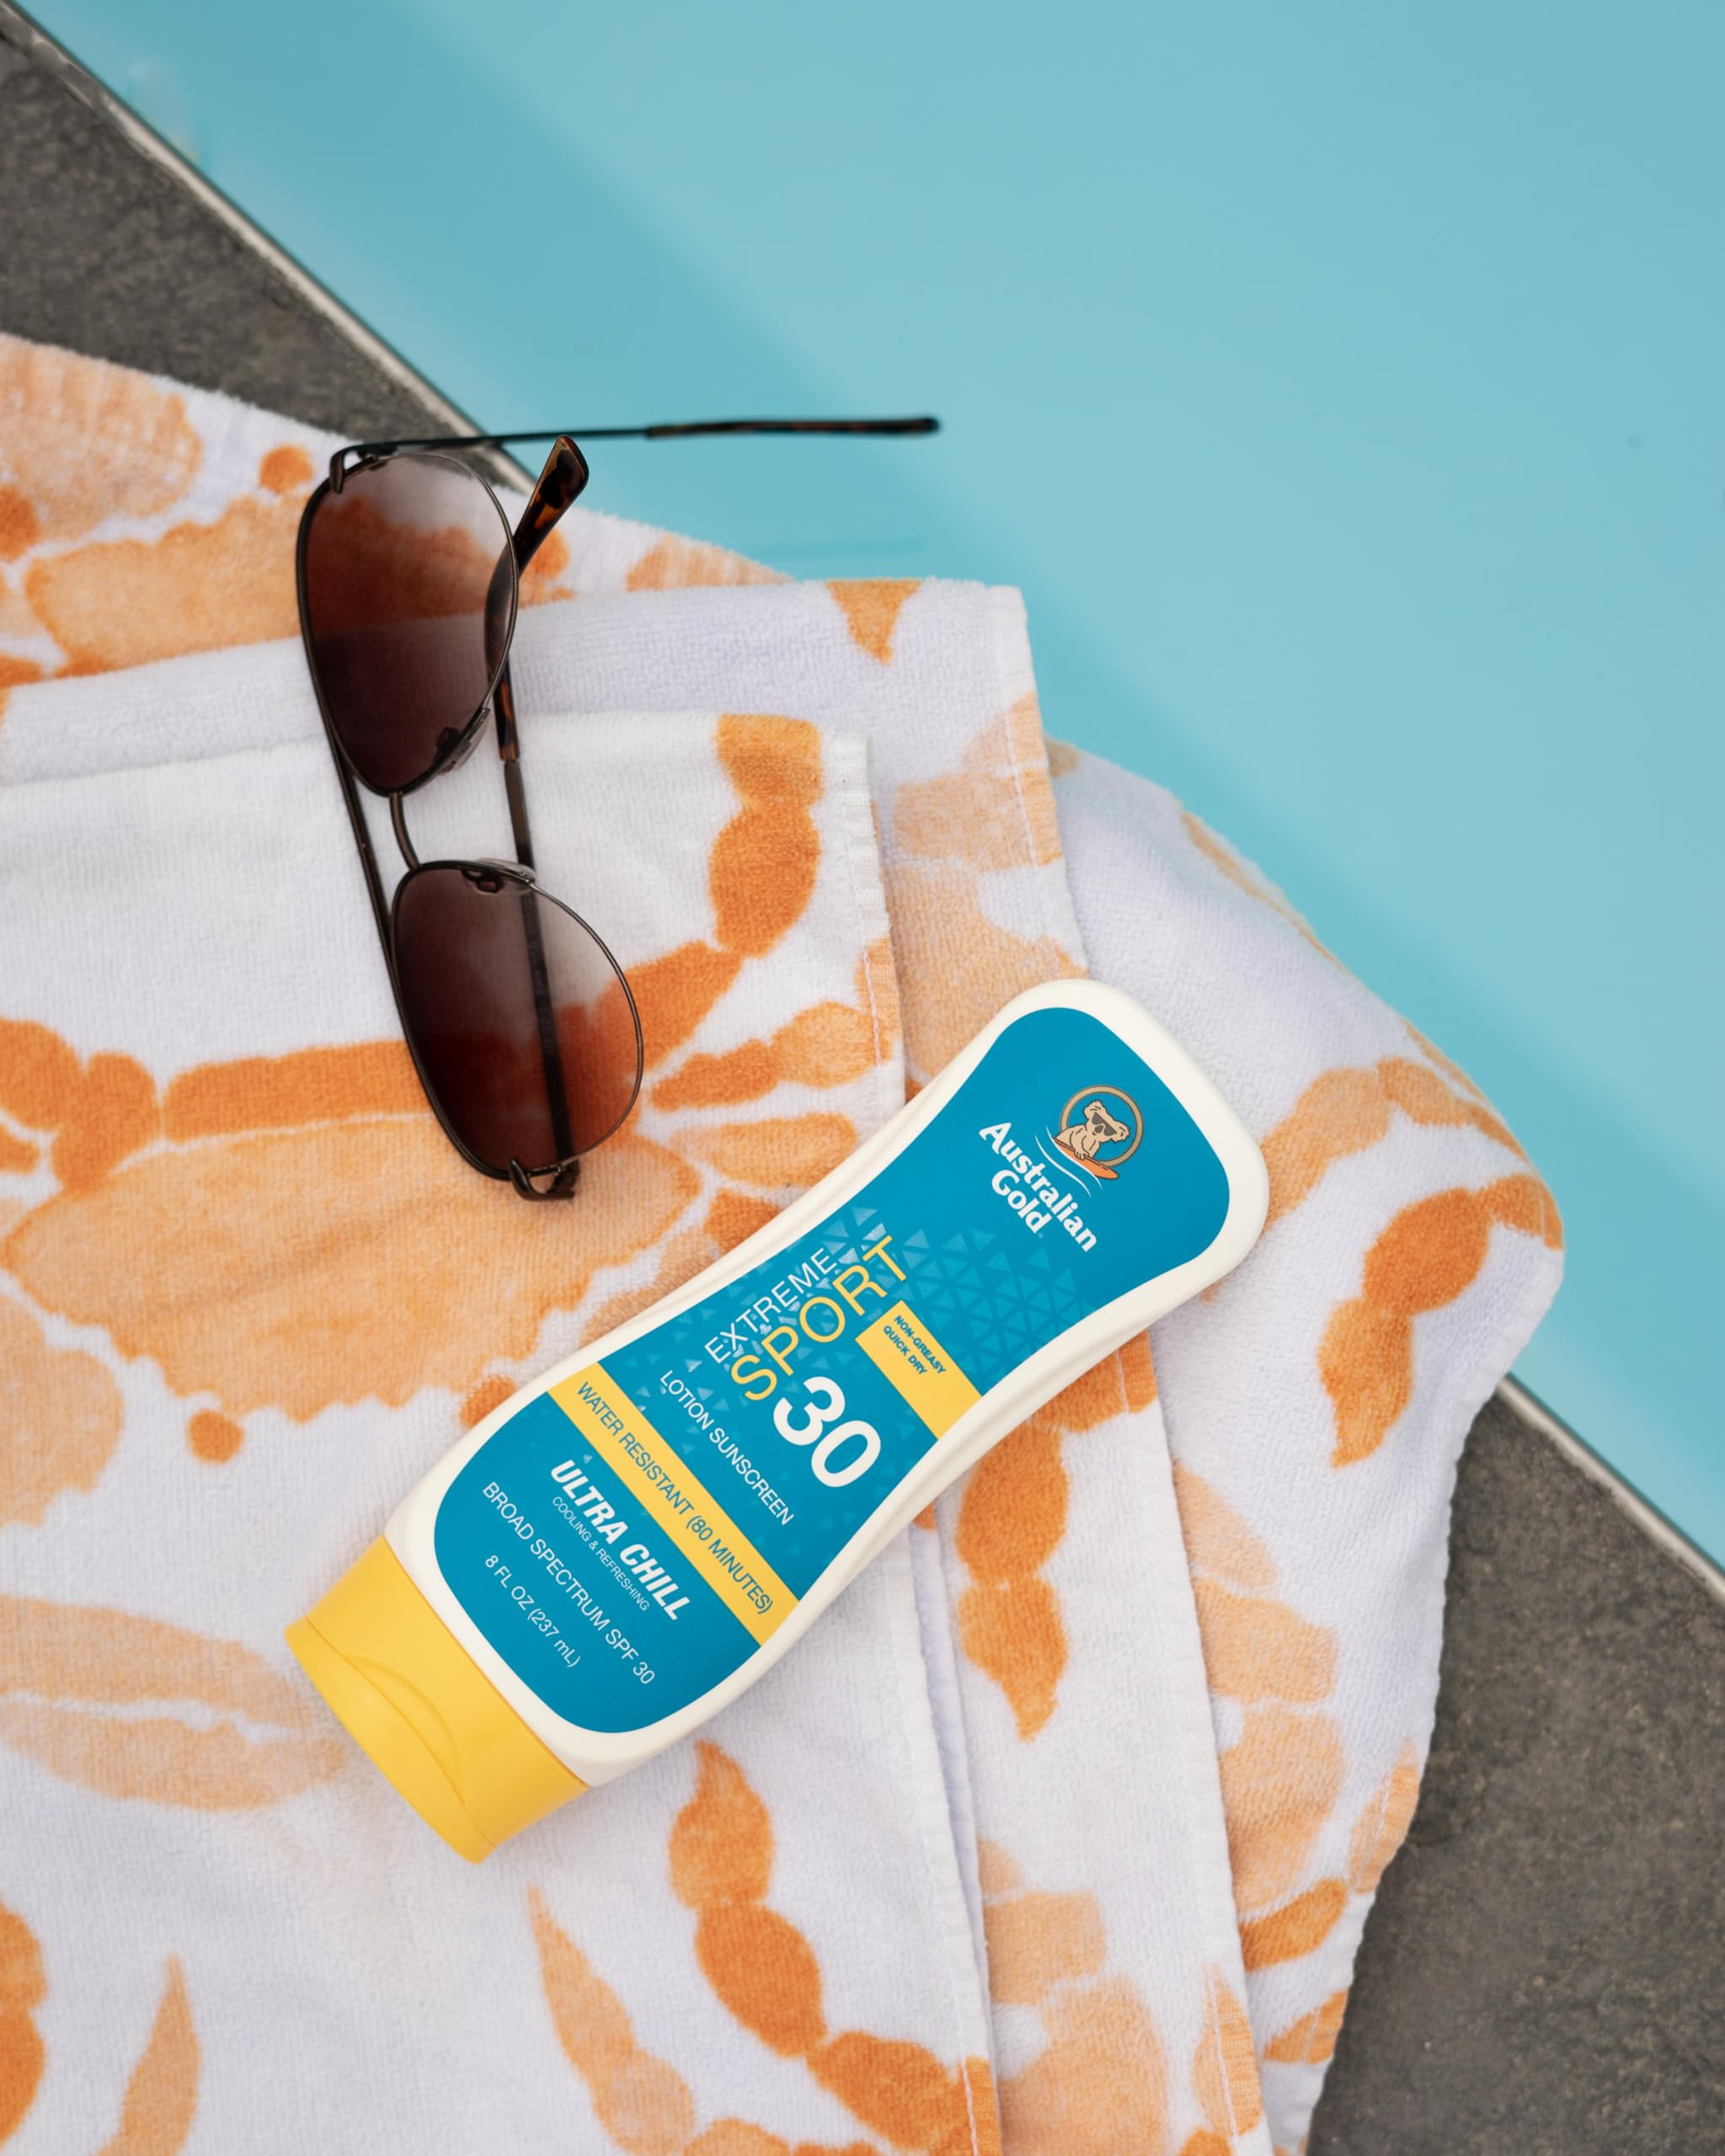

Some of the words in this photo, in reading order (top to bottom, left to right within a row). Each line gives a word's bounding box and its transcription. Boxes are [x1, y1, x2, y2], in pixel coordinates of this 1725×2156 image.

[979, 1122, 1097, 1252] Australian
[991, 1169, 1052, 1234] Gold
[704, 1248, 837, 1364] EXTREME
[731, 1235, 906, 1401] SPORT
[884, 1326, 910, 1356] QUICK
[908, 1354, 927, 1374] DRY
[895, 1315, 946, 1374] NON-GREASY
[660, 1370, 714, 1431] LOTION
[708, 1428, 795, 1526] SUNSCREEN
[773, 1376, 881, 1488] 30
[551, 1460, 628, 1545] ULTRA
[620, 1543, 690, 1620] CHILL
[553, 1497, 592, 1542] COOLING
[589, 1540, 598, 1550] &
[595, 1549, 649, 1611] REFRESHING
[577, 1381, 624, 1437] WATER
[619, 1433, 694, 1516] RESISTANT
[686, 1515, 713, 1542] (80
[708, 1539, 774, 1614] MINUTES)
[483, 1481, 534, 1540] BROAD
[531, 1539, 610, 1630] SPECTRUM
[605, 1629, 639, 1662] SPF
[633, 1661, 654, 1685] 30
[485, 1555, 499, 1569] 8
[494, 1563, 512, 1588] FL
[511, 1585, 534, 1611] OZ
[527, 1608, 559, 1637] (237
[554, 1636, 581, 1668] mL)
